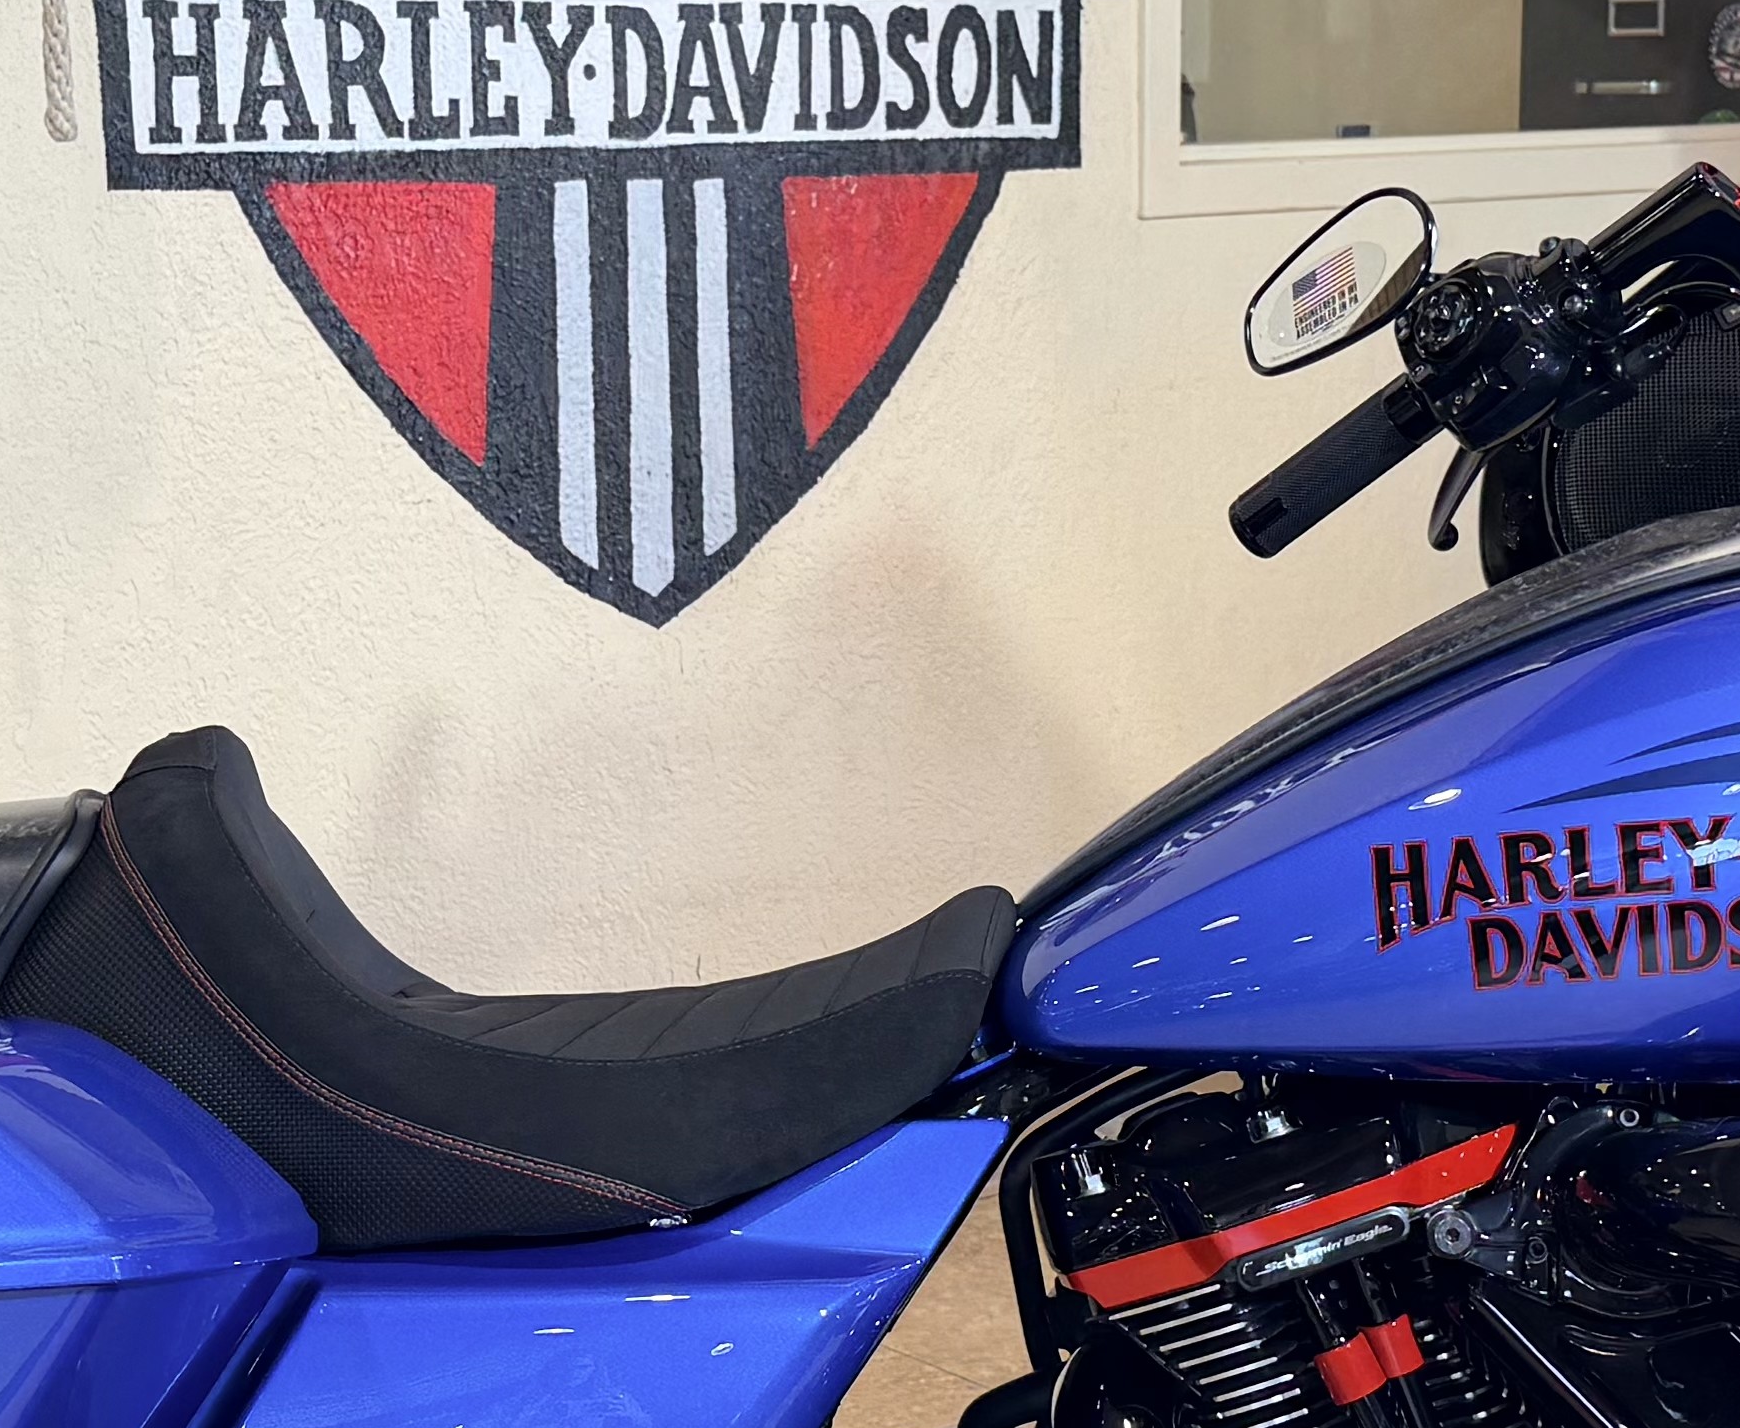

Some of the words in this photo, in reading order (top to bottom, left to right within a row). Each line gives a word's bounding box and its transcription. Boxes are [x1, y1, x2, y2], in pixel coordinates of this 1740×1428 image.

[1296, 305, 1338, 341] ASSEMBLED
[1256, 1238, 1343, 1277] Scmin'
[1343, 1224, 1393, 1247] Eagle
